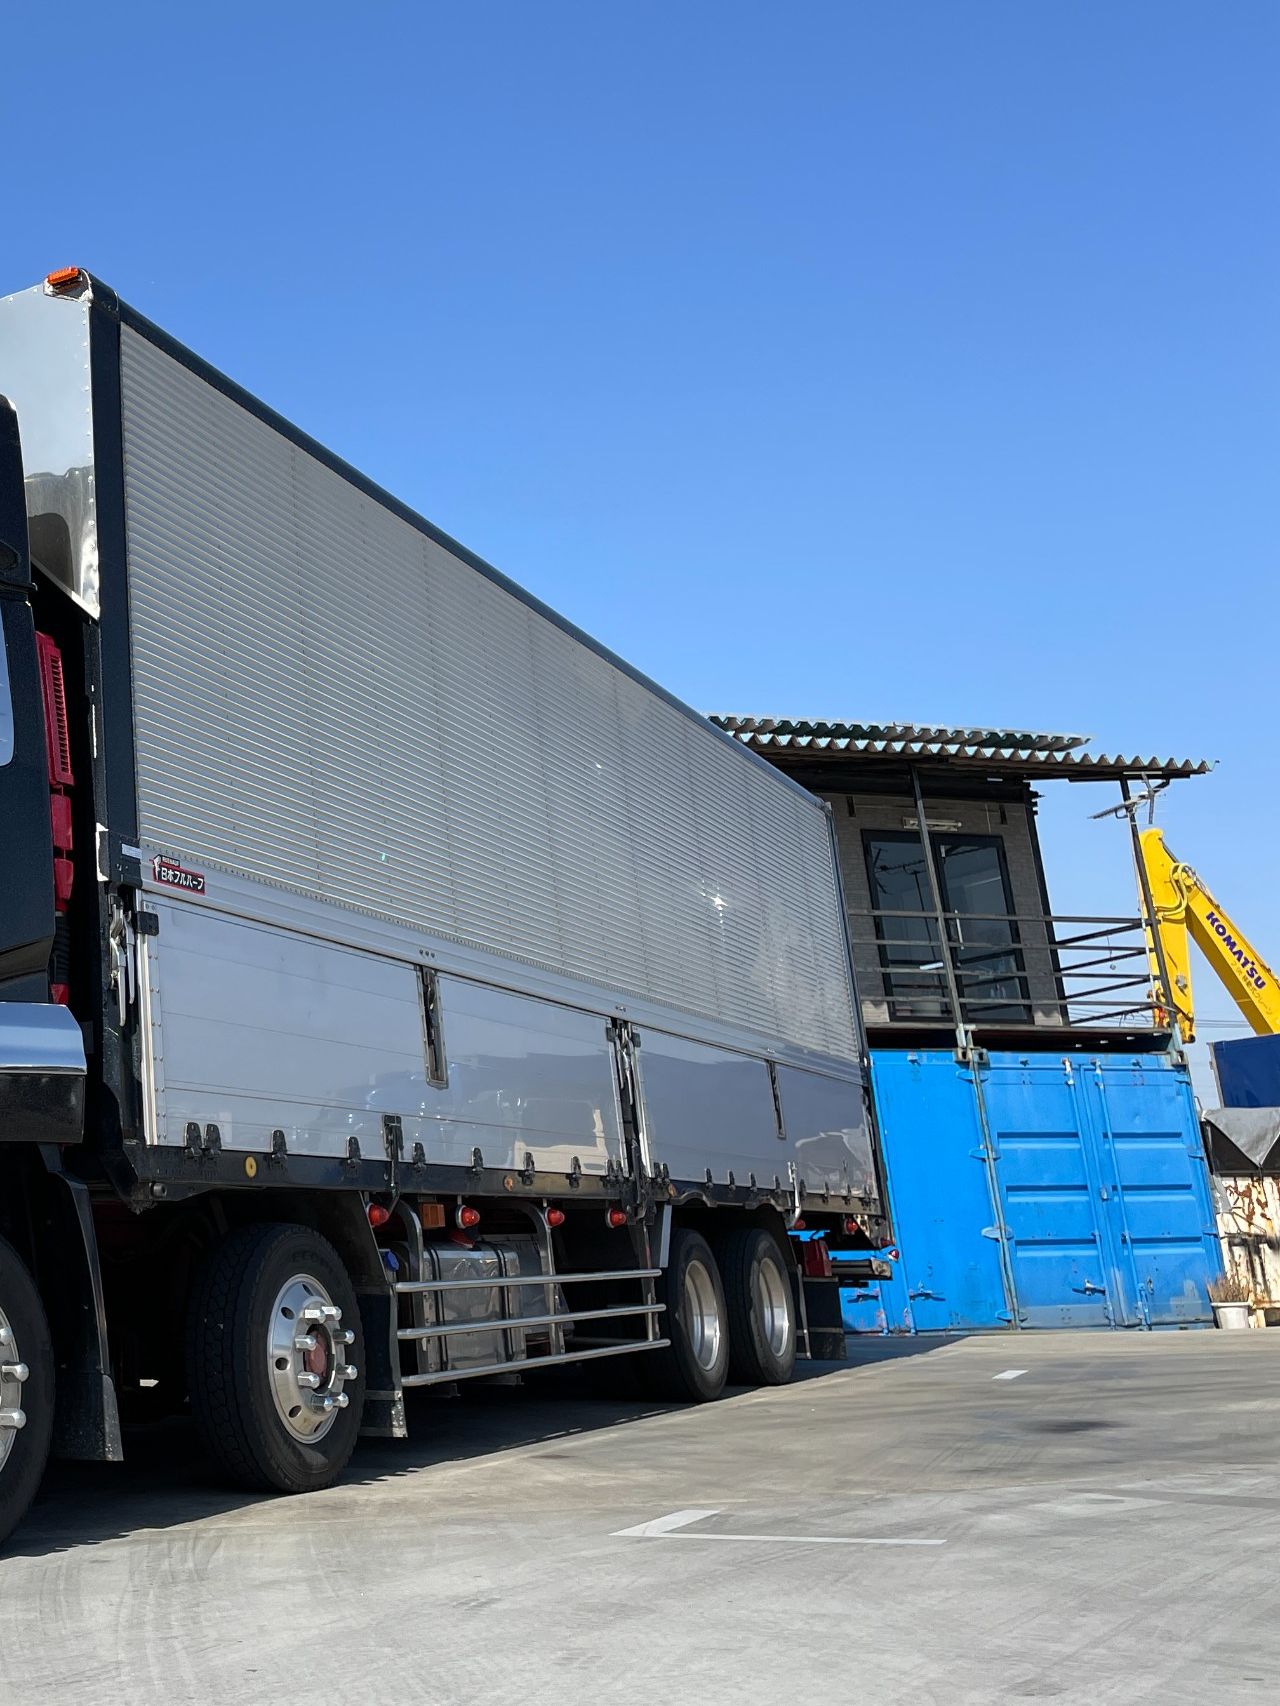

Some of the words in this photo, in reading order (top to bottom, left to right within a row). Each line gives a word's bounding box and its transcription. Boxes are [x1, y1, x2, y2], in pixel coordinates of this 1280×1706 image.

[161, 867, 204, 890] 日本フルハーフ
[1205, 911, 1266, 990] KOMATSU
